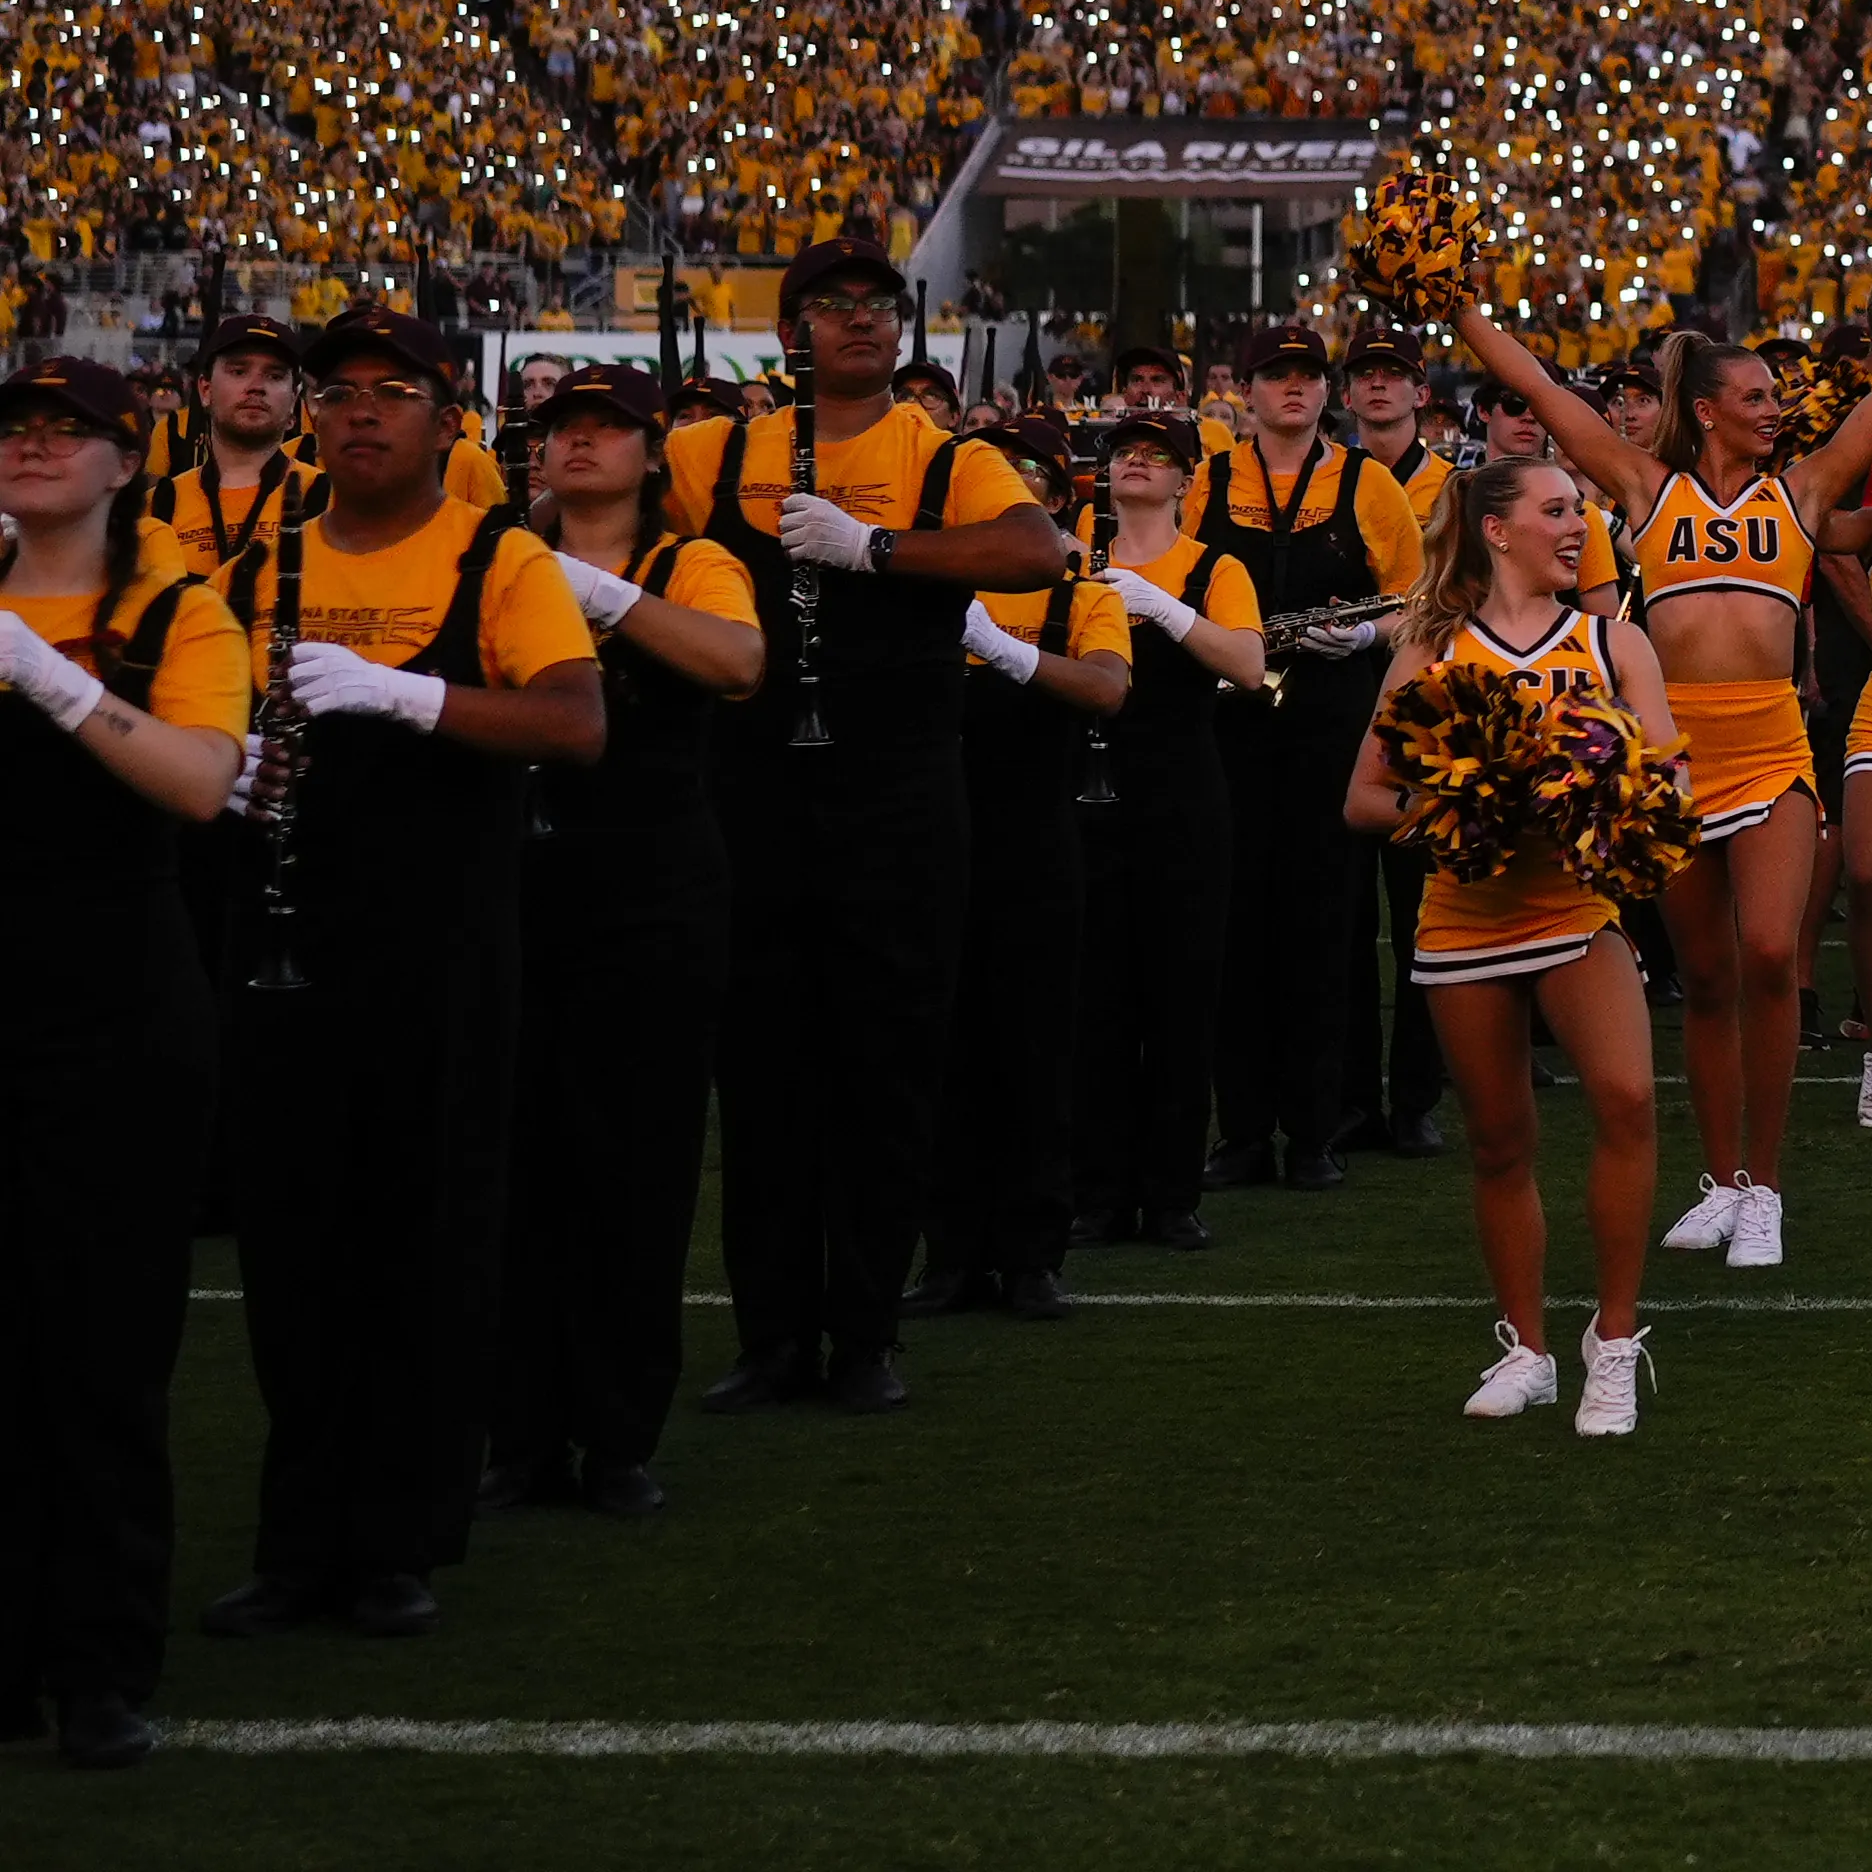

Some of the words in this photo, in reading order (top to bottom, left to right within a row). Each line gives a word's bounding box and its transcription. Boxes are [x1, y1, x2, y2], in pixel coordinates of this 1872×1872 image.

[1016, 137, 1167, 160] GILA
[1181, 140, 1378, 161] RIVER
[1665, 514, 1781, 566] ASU
[328, 608, 381, 622] STATE
